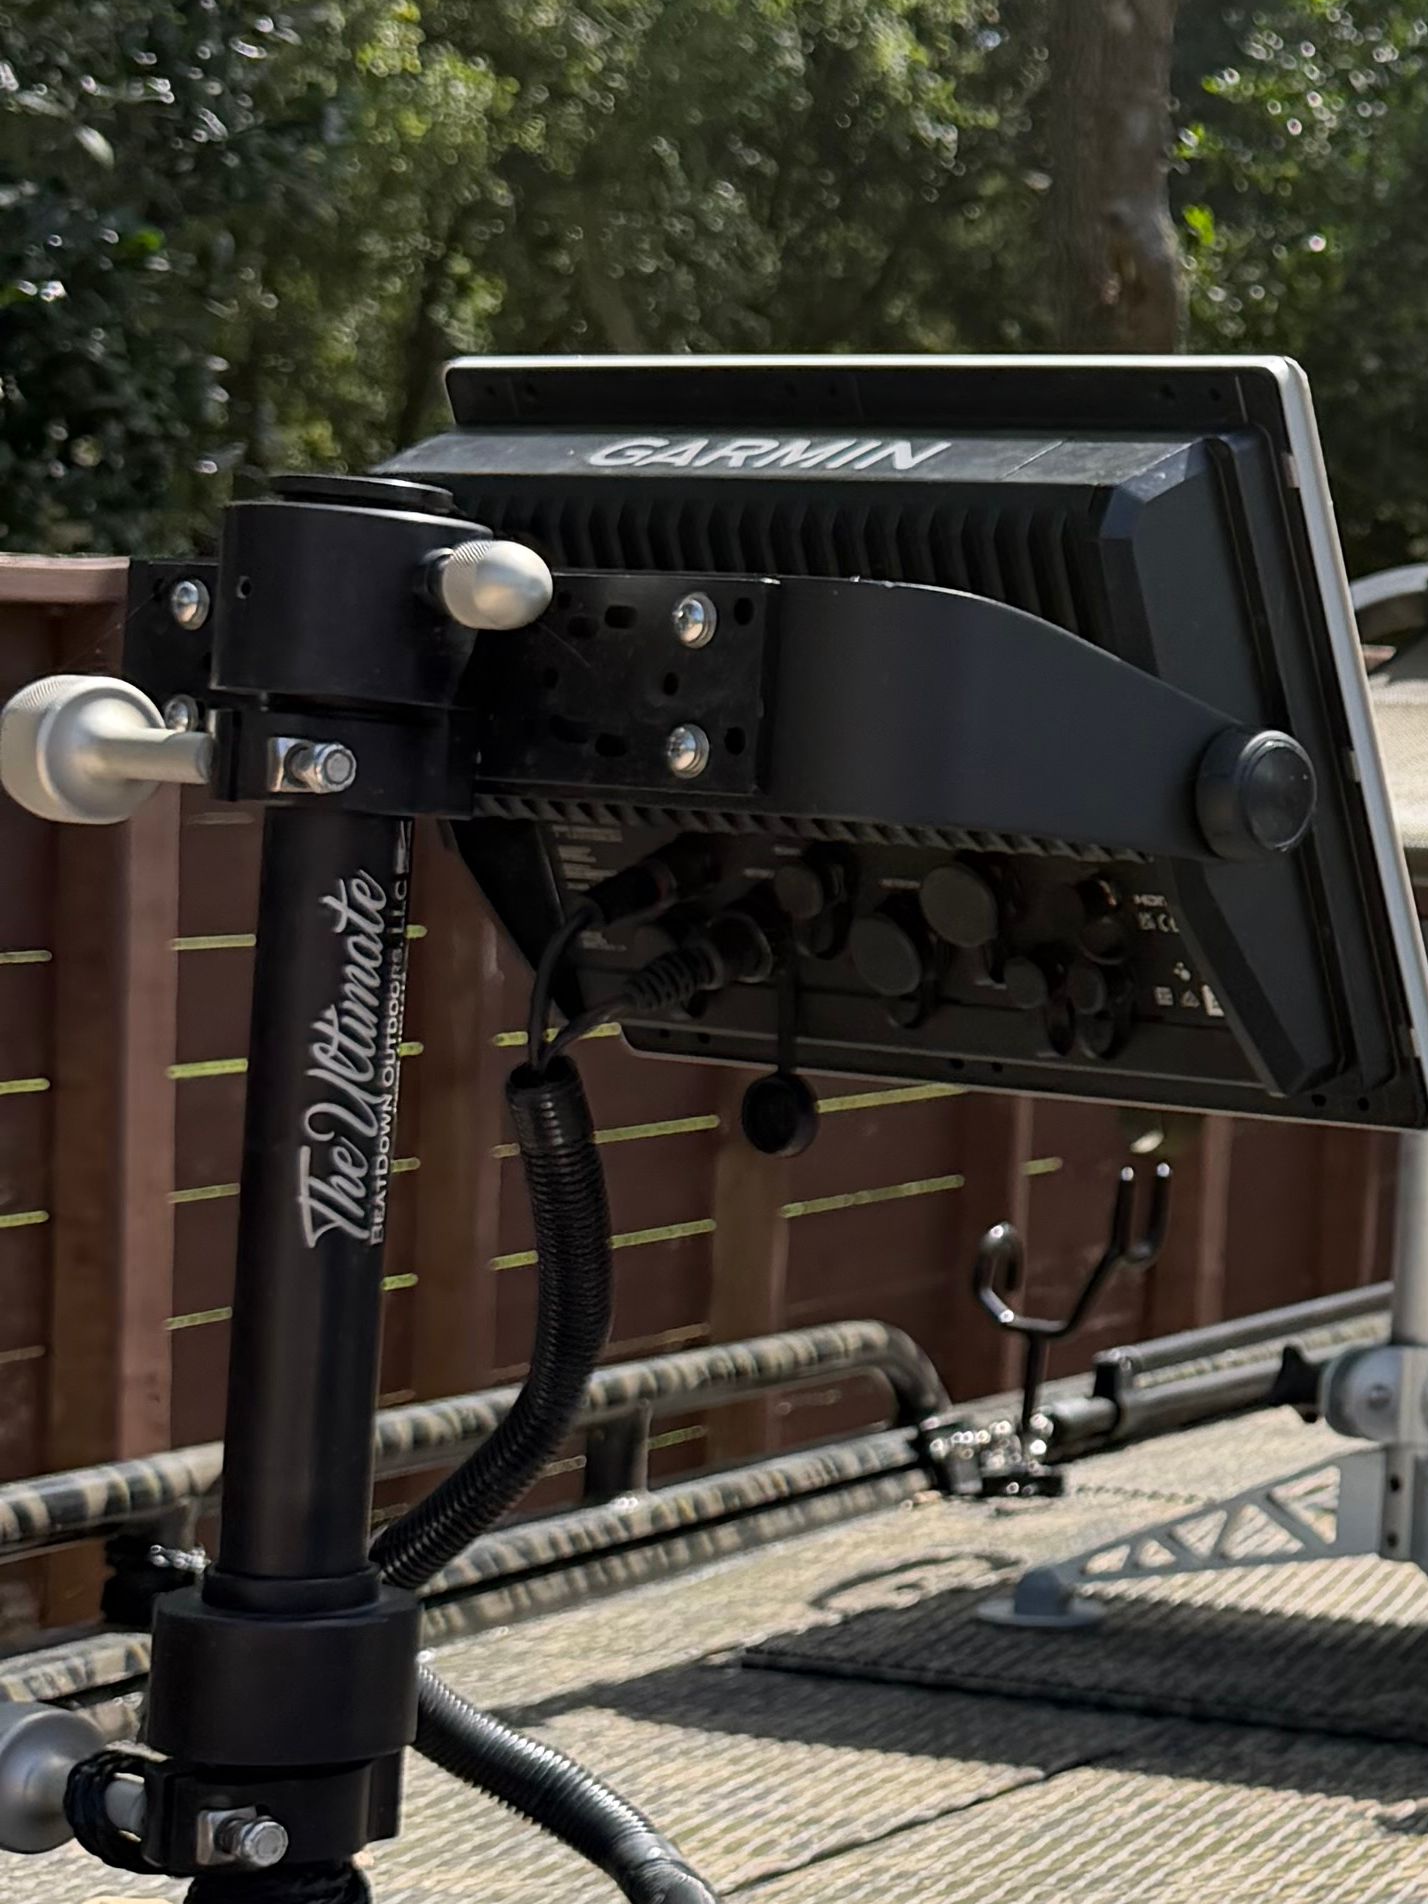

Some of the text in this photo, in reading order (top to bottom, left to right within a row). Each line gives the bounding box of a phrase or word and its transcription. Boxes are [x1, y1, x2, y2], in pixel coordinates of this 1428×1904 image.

[589, 437, 952, 470] GARMIN
[390, 879, 408, 934] LLC
[299, 869, 387, 1249] The Ultimate
